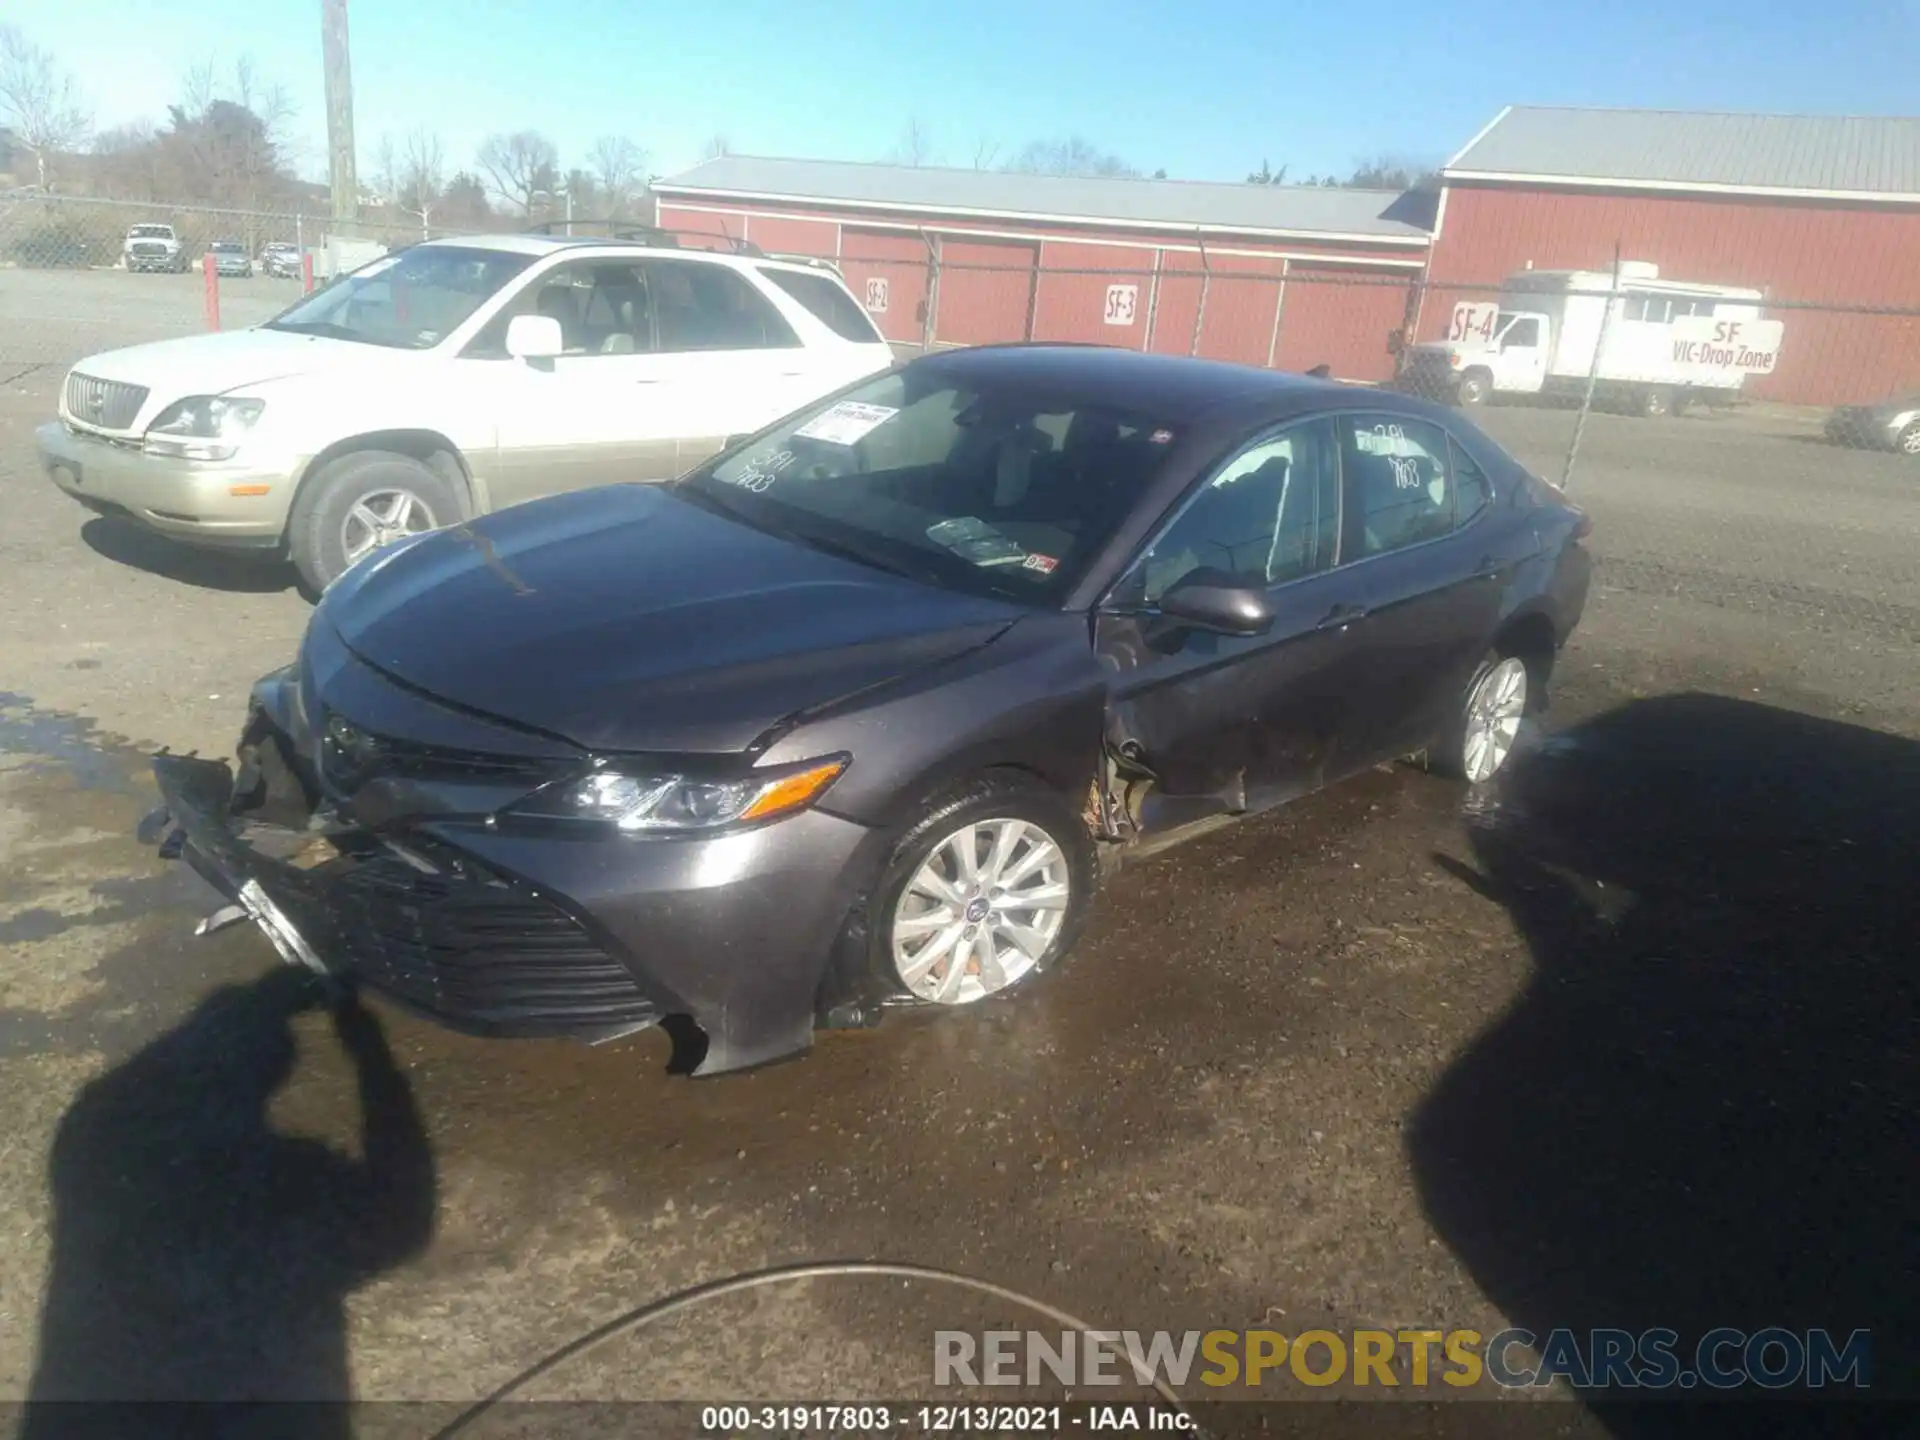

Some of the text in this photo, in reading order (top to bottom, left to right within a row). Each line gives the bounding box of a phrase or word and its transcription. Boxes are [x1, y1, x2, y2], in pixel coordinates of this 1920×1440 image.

[868, 282, 887, 308] SF-2
[1107, 289, 1136, 319] SF-3
[1450, 307, 1494, 342] SF-4
[1711, 320, 1742, 343] SF
[1672, 339, 1774, 368] VIC-Drop Zone
